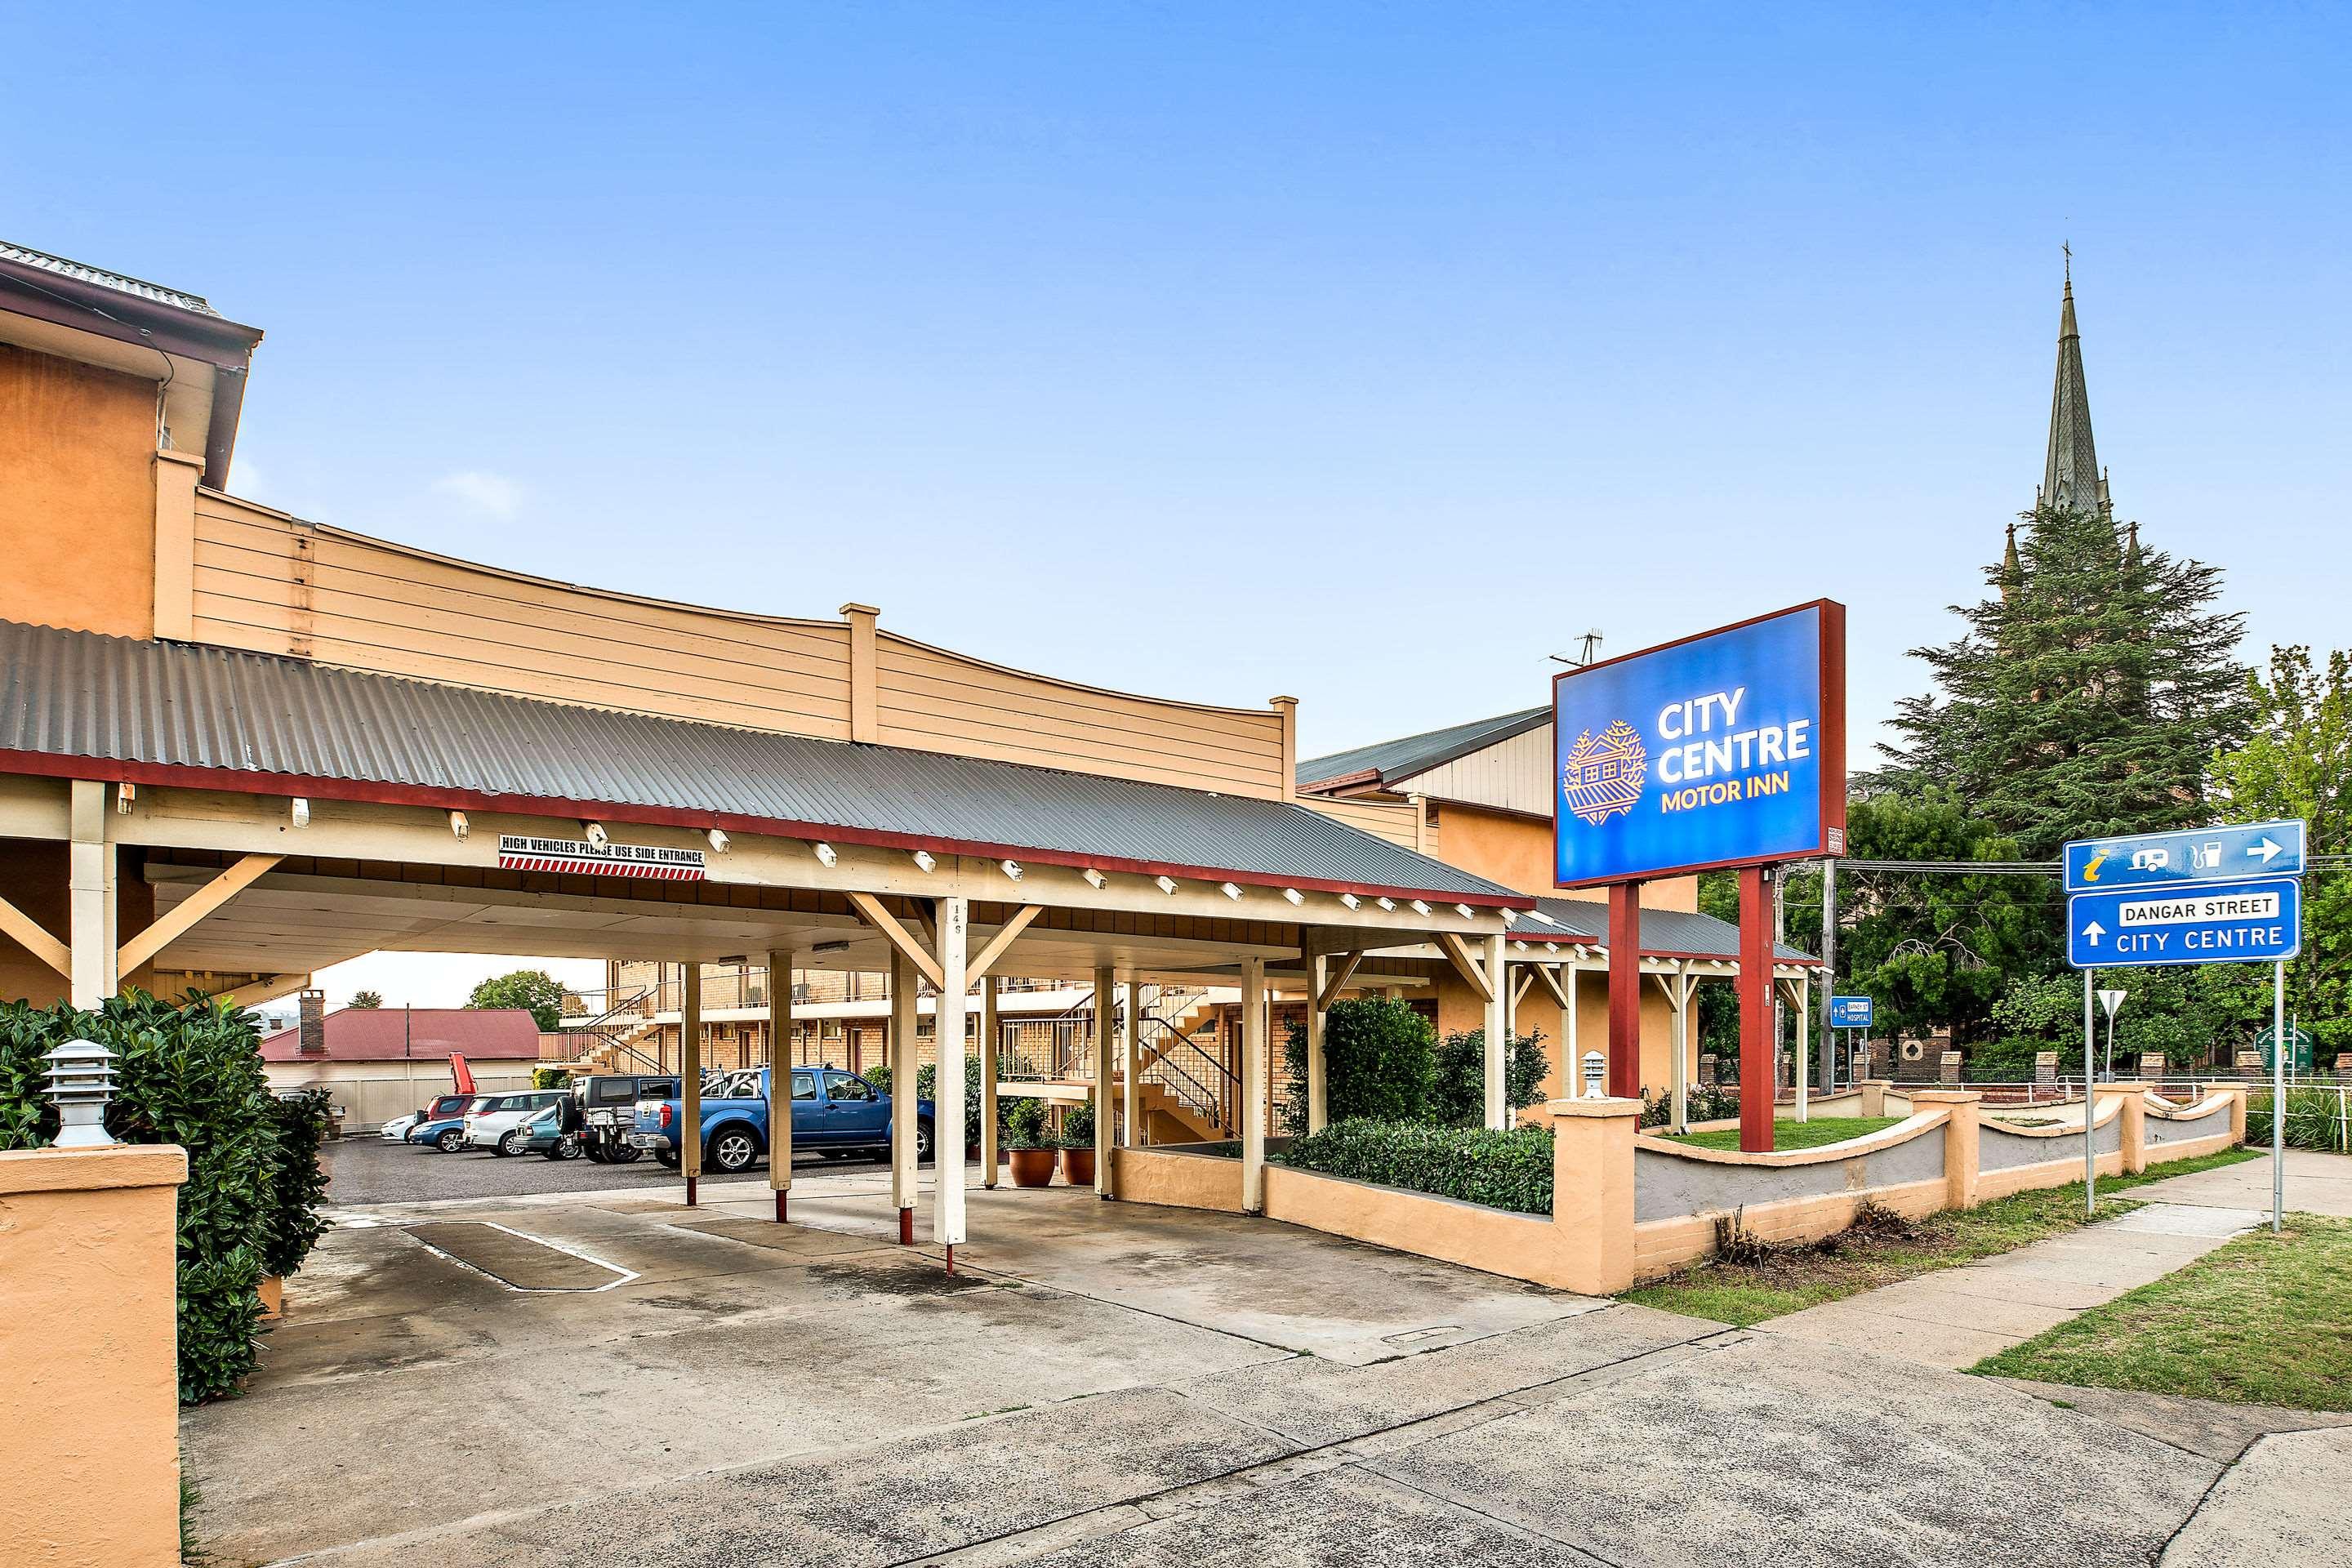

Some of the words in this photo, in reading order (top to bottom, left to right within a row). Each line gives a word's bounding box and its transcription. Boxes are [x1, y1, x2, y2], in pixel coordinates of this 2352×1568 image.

[1657, 687, 1745, 740] CITY
[1658, 719, 1810, 783] CENTRE
[1661, 782, 1741, 813] MOTOR
[1746, 771, 1789, 798] INN
[502, 836, 528, 849] HIGH
[531, 839, 576, 853] VEHICLES
[615, 845, 632, 858] USE
[635, 847, 656, 859] SIDE
[658, 849, 702, 862] ENTRANCE
[2125, 904, 2196, 921] DANGAR
[2205, 898, 2273, 916] STREET
[2117, 933, 2170, 953] CITY
[2185, 926, 2283, 950] CENTRE
[1847, 1013, 1869, 1022] HOSPITAL
